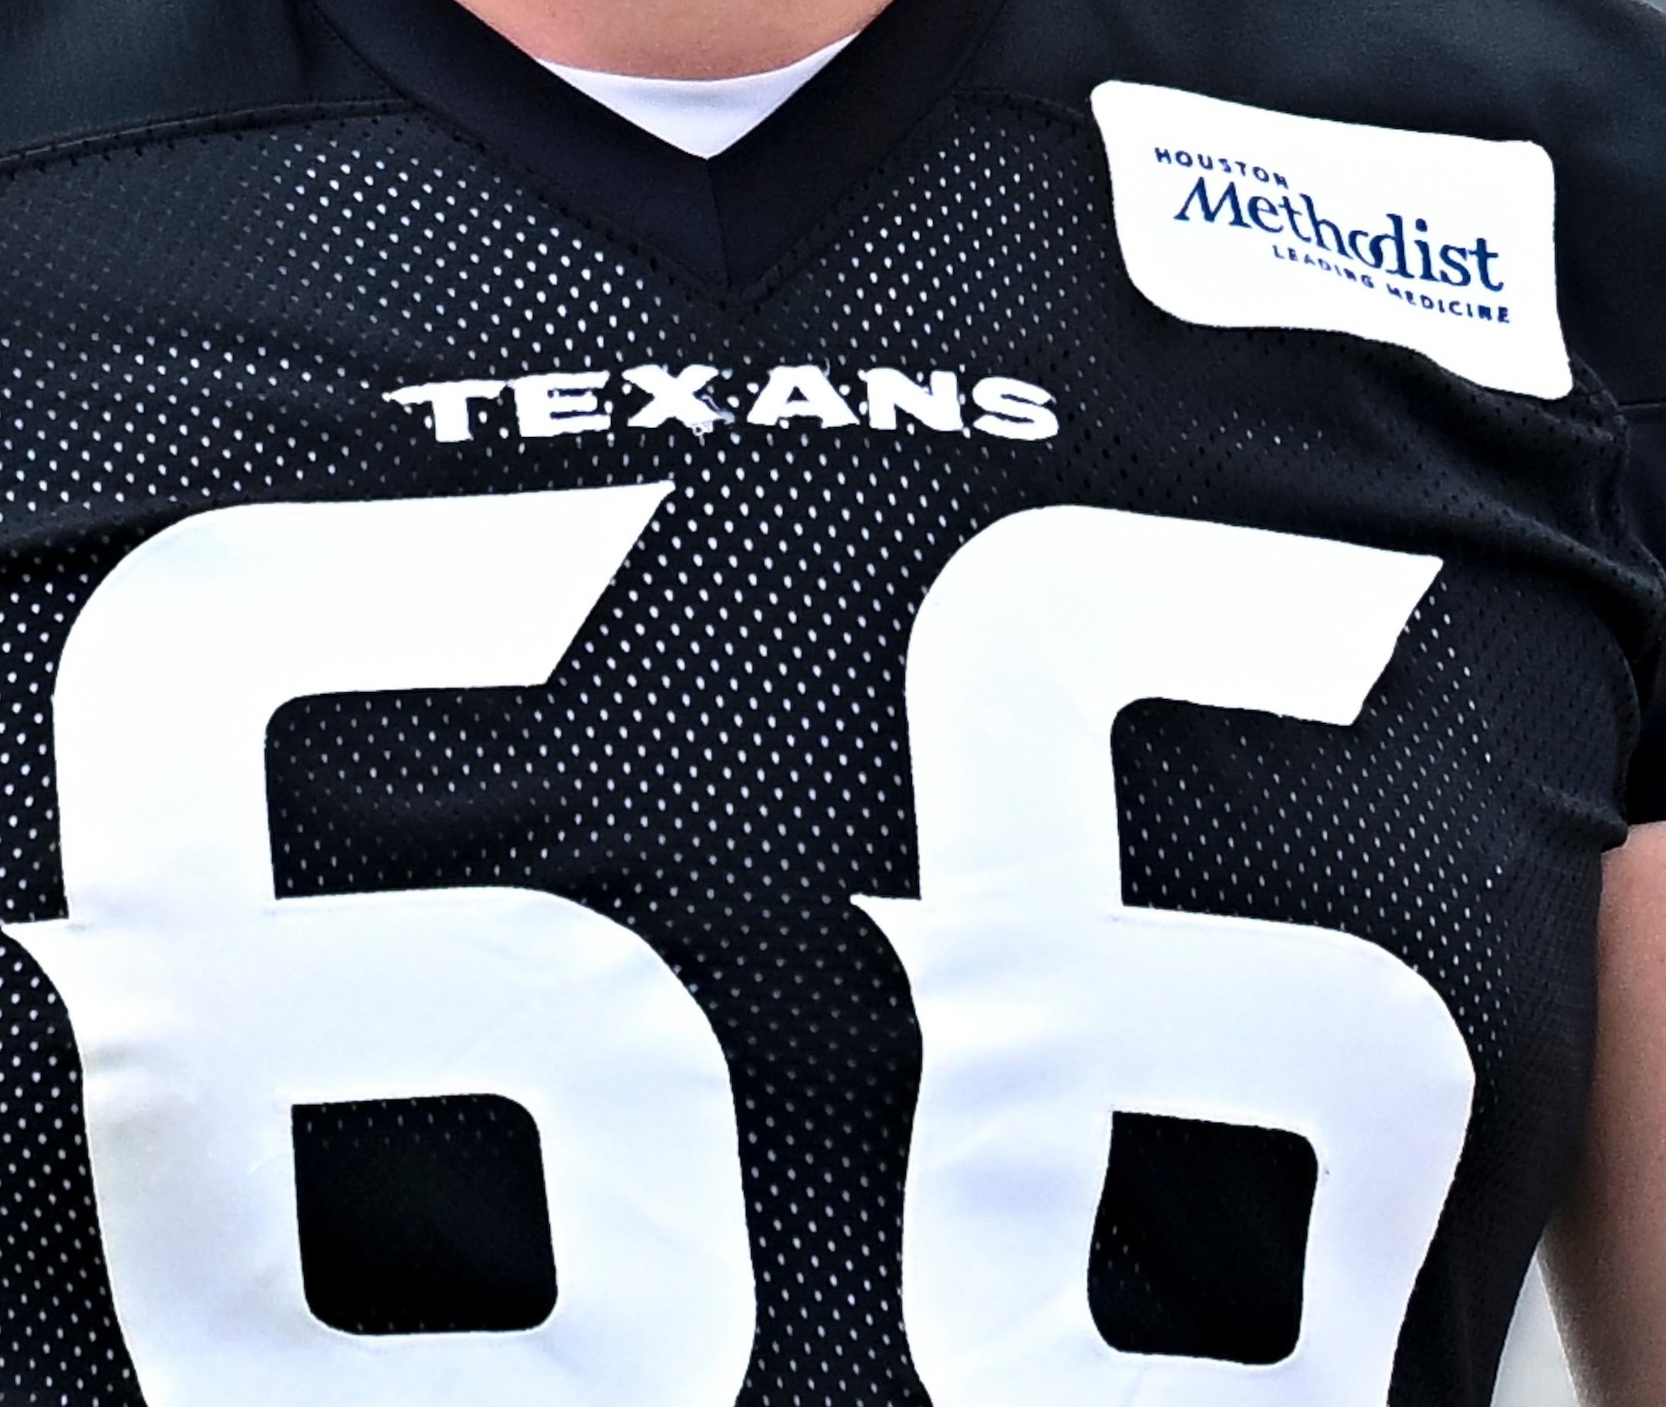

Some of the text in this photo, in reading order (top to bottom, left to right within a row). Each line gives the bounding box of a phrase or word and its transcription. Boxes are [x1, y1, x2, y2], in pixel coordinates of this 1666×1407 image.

[1154, 147, 1289, 190] HOUSTON
[1173, 176, 1504, 292] Methodist
[1272, 245, 1510, 323] LEADING MEDICINE
[382, 364, 1059, 441] TEXANS
[0, 481, 1476, 1407] 66
